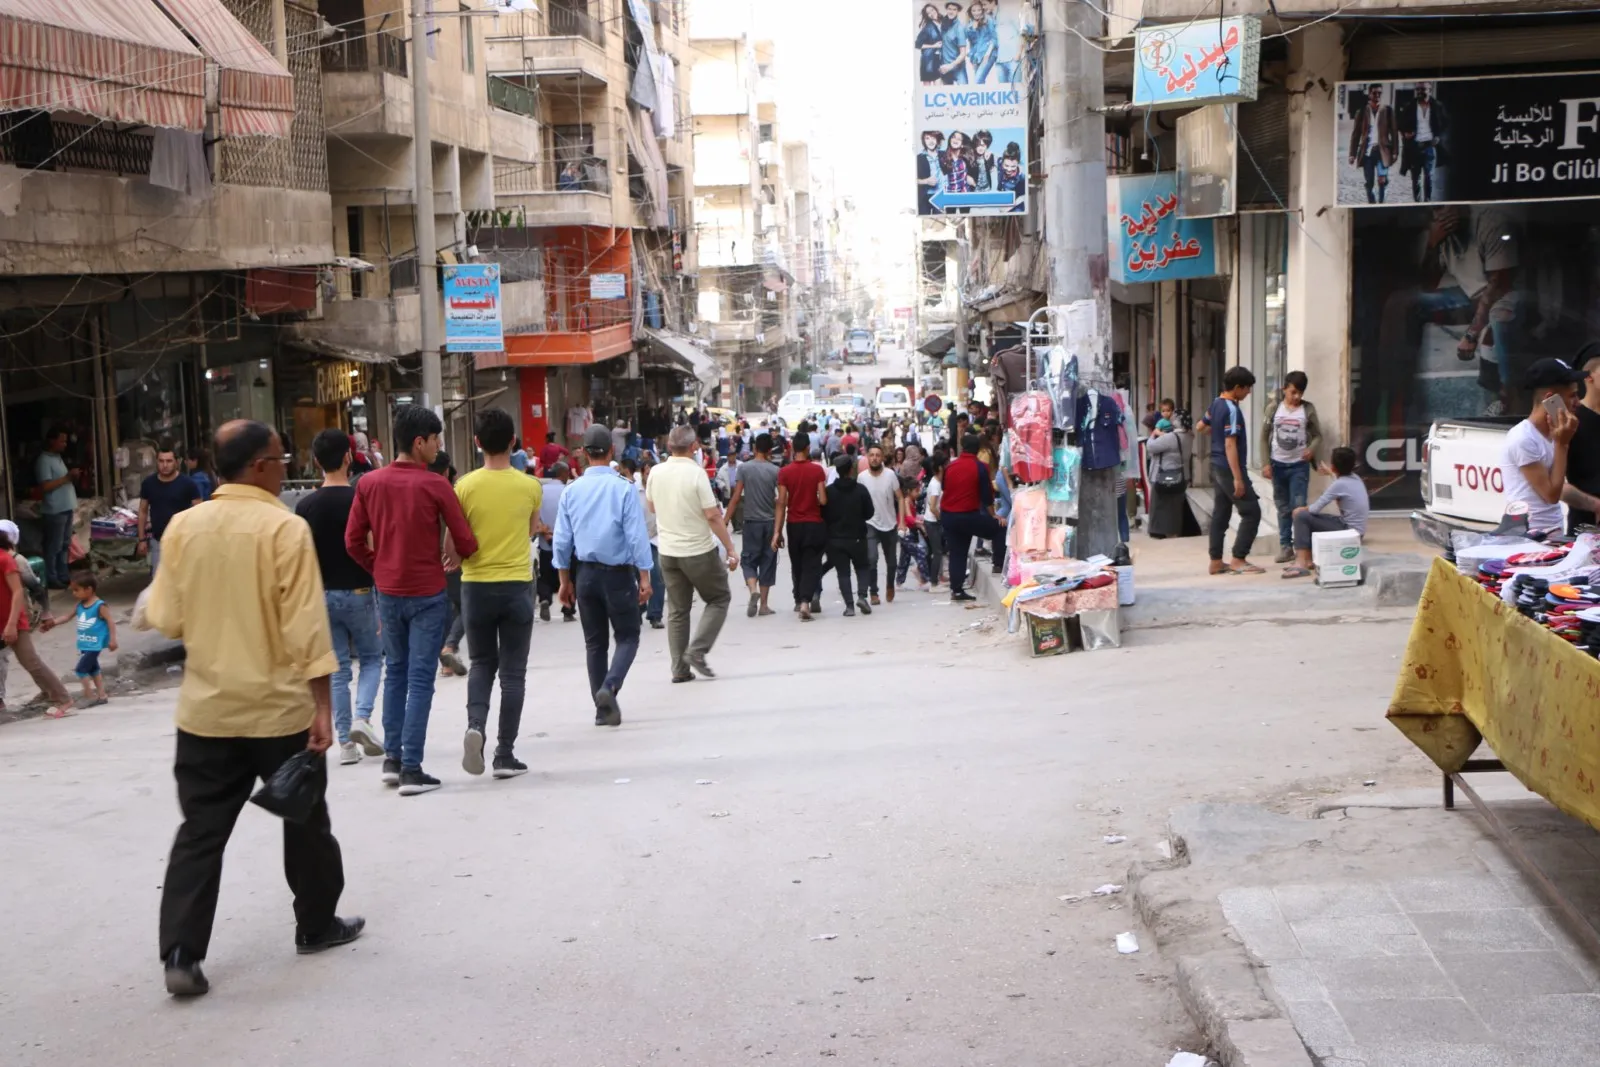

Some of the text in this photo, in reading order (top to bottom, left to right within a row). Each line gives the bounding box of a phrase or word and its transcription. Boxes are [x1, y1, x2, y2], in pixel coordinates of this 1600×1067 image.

[1158, 26, 1238, 92] صيدلية
[924, 93, 947, 107] LC
[1497, 102, 1552, 126] للألبسة
[1493, 127, 1554, 149] الرجالية
[1557, 97, 1600, 150] F
[1491, 163, 1508, 183] Ji
[1516, 163, 1545, 182] Bo
[1129, 232, 1201, 272] عفرين
[1365, 438, 1422, 471] CL
[1454, 463, 1504, 493] TOYO
